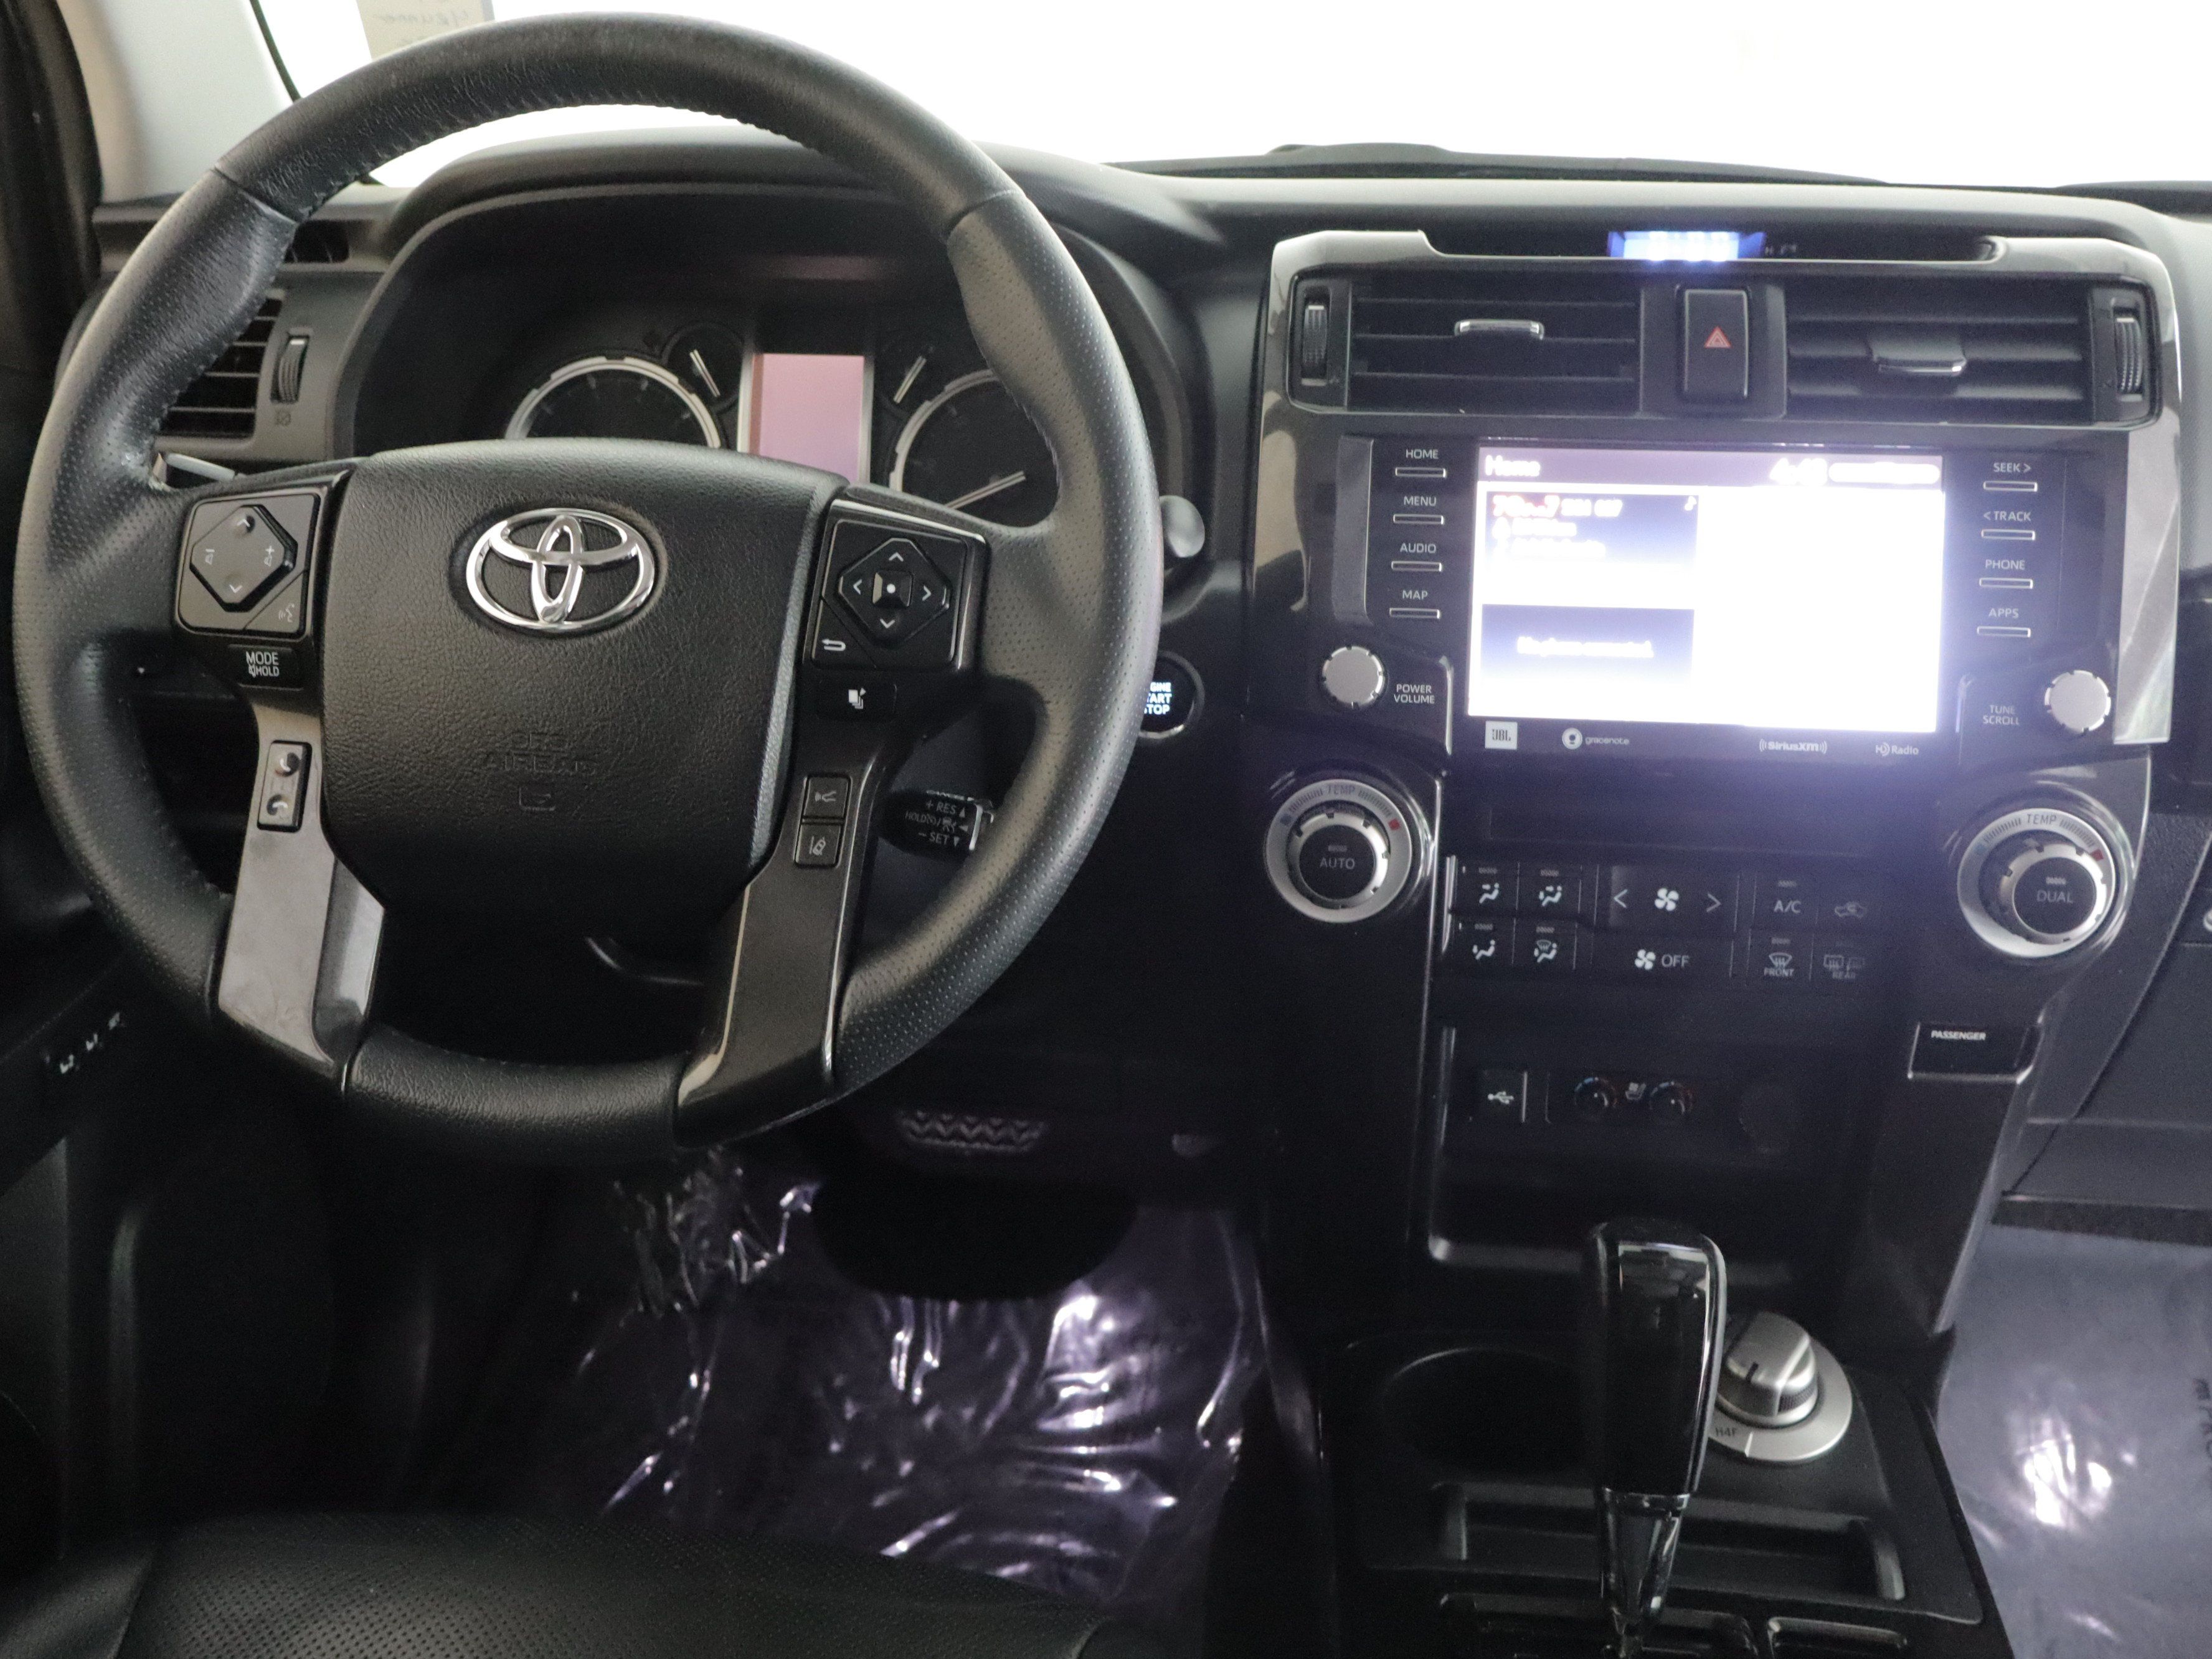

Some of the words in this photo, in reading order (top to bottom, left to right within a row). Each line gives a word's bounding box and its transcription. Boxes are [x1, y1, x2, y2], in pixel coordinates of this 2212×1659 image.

[1405, 448, 1439, 460] HOME
[1993, 461, 2021, 473] SEEK
[1403, 496, 1437, 507] MENU
[1993, 510, 2031, 522] TRACK
[1399, 542, 1437, 554] AUDIO
[1985, 559, 2026, 570] PHONE
[1402, 589, 1428, 600] MAP
[1988, 607, 2020, 619] APPS
[245, 651, 280, 666] MODE
[255, 664, 280, 678] HOLD
[1150, 681, 1172, 692] GINE
[1396, 684, 1432, 694] POWER
[1393, 694, 1435, 705] VOLUME
[1989, 704, 2016, 716] TUNE
[1982, 714, 2020, 726] SCROLL
[1491, 728, 1511, 742] JBL
[1891, 744, 1919, 755] Radio
[1327, 785, 1356, 795] TEMP
[936, 801, 957, 815] RES
[2026, 813, 2057, 825] TEMP
[929, 832, 950, 846] SET
[1320, 857, 1356, 871] AUTO
[2036, 890, 2074, 903] DUAL
[1773, 900, 1802, 914] A/C
[1661, 955, 1690, 968] OFF
[1763, 967, 1795, 978] FRONT
[1931, 1029, 1987, 1041] PASSENGER
